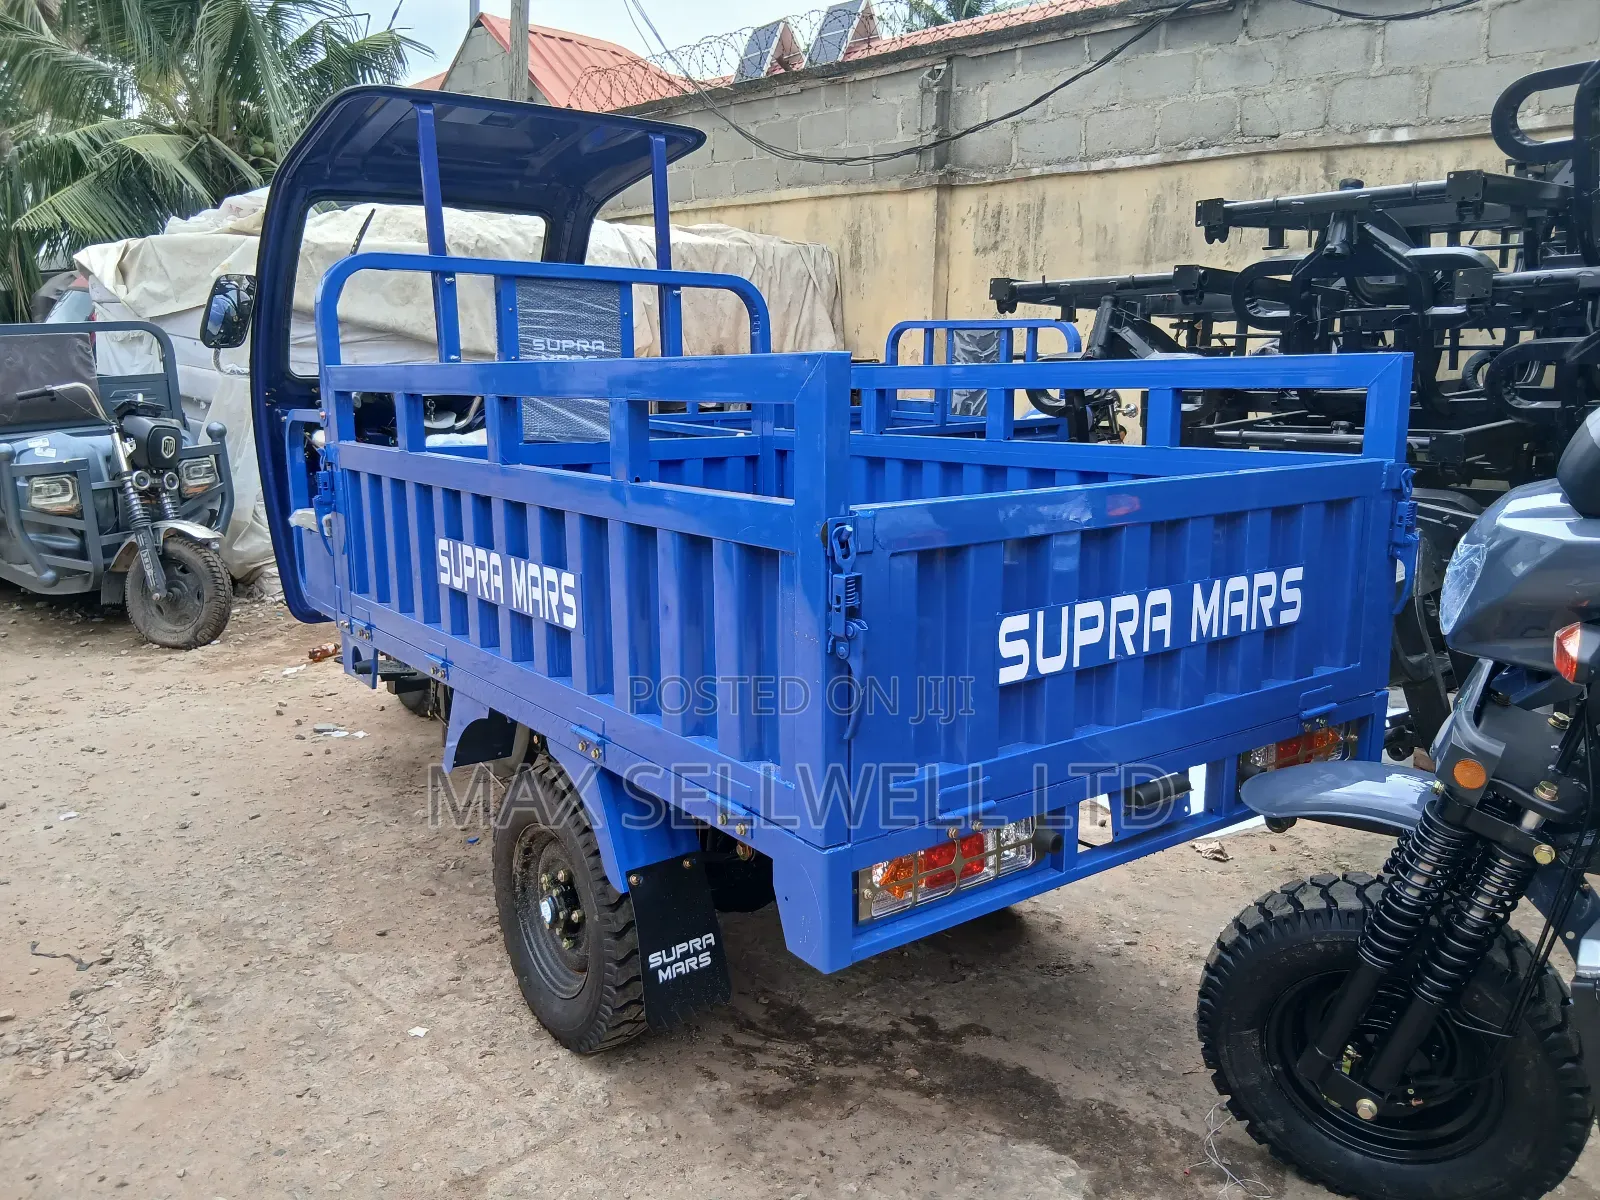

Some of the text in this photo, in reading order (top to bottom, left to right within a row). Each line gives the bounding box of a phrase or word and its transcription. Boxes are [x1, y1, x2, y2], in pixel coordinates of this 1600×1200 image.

[532, 338, 604, 352] SUPRA
[438, 538, 577, 629] SUPRA MARS
[998, 566, 1304, 685] SUPRA MARS
[648, 932, 716, 969] SUPRA
[657, 951, 712, 985] MARS
